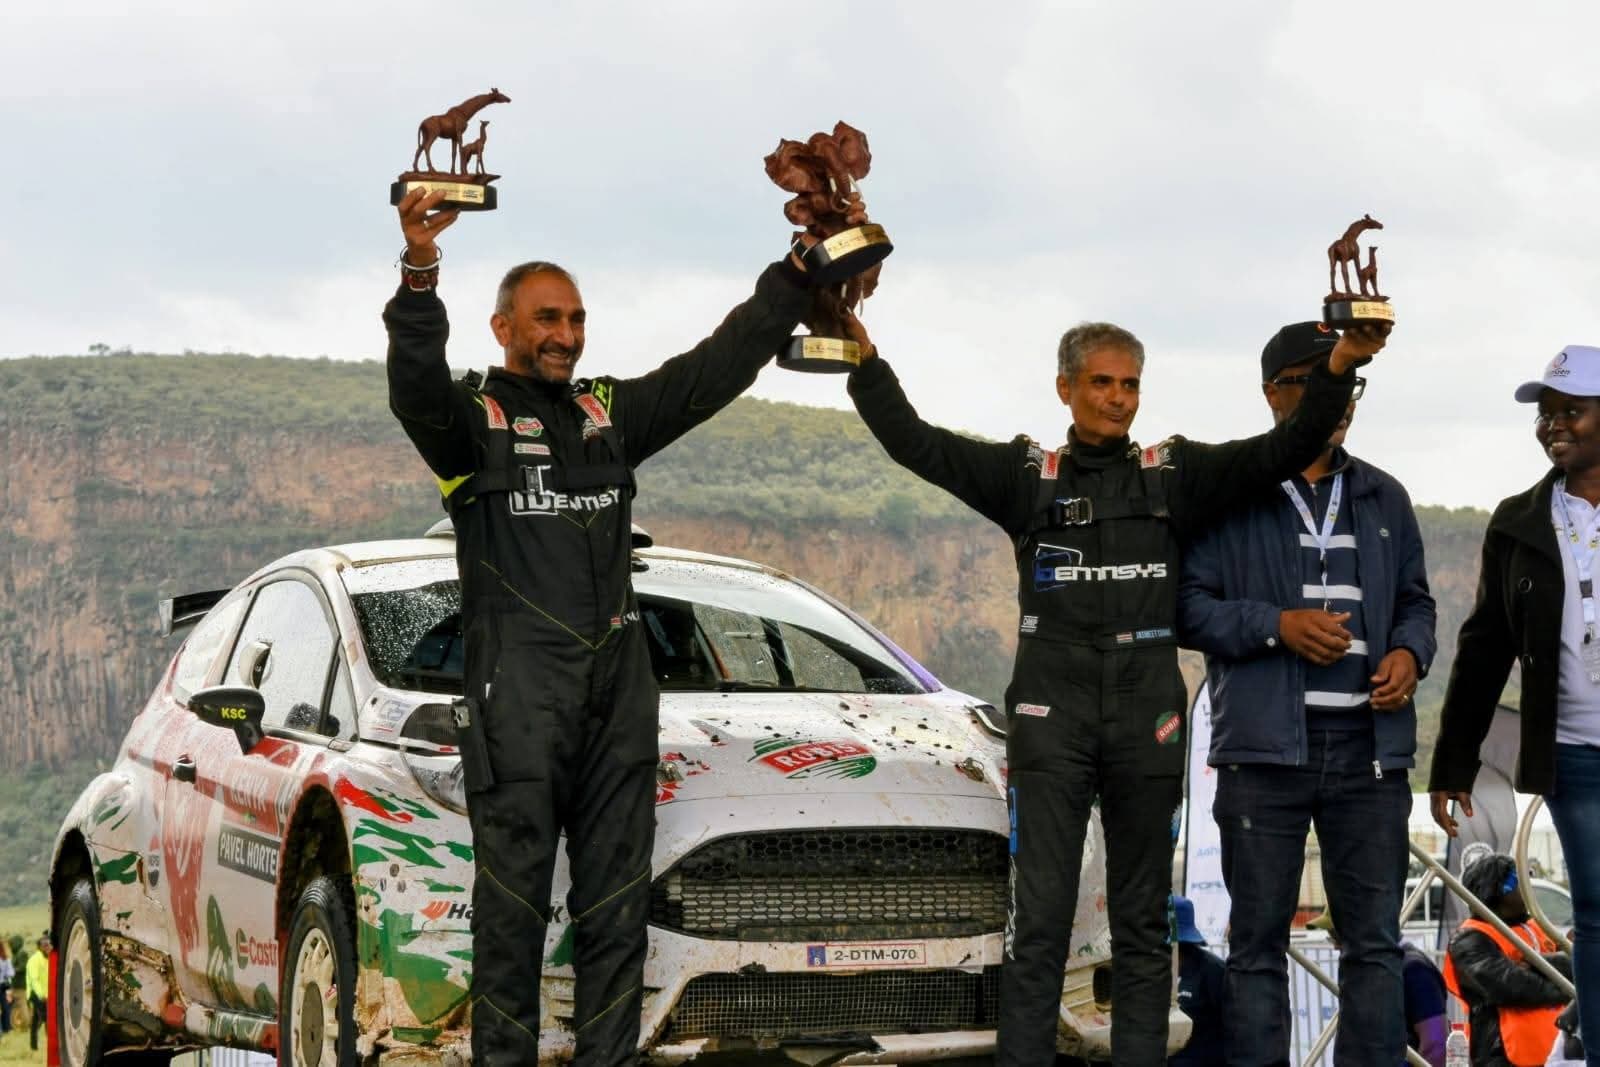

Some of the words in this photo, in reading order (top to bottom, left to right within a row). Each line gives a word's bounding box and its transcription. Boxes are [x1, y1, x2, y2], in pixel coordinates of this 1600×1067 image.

[221, 707, 247, 720] KSC
[774, 742, 859, 767] RUBIS
[220, 832, 245, 865] PAVEL
[247, 841, 281, 876] HORTE
[250, 936, 278, 968] Castr
[834, 949, 918, 961] 2-DTM-070
